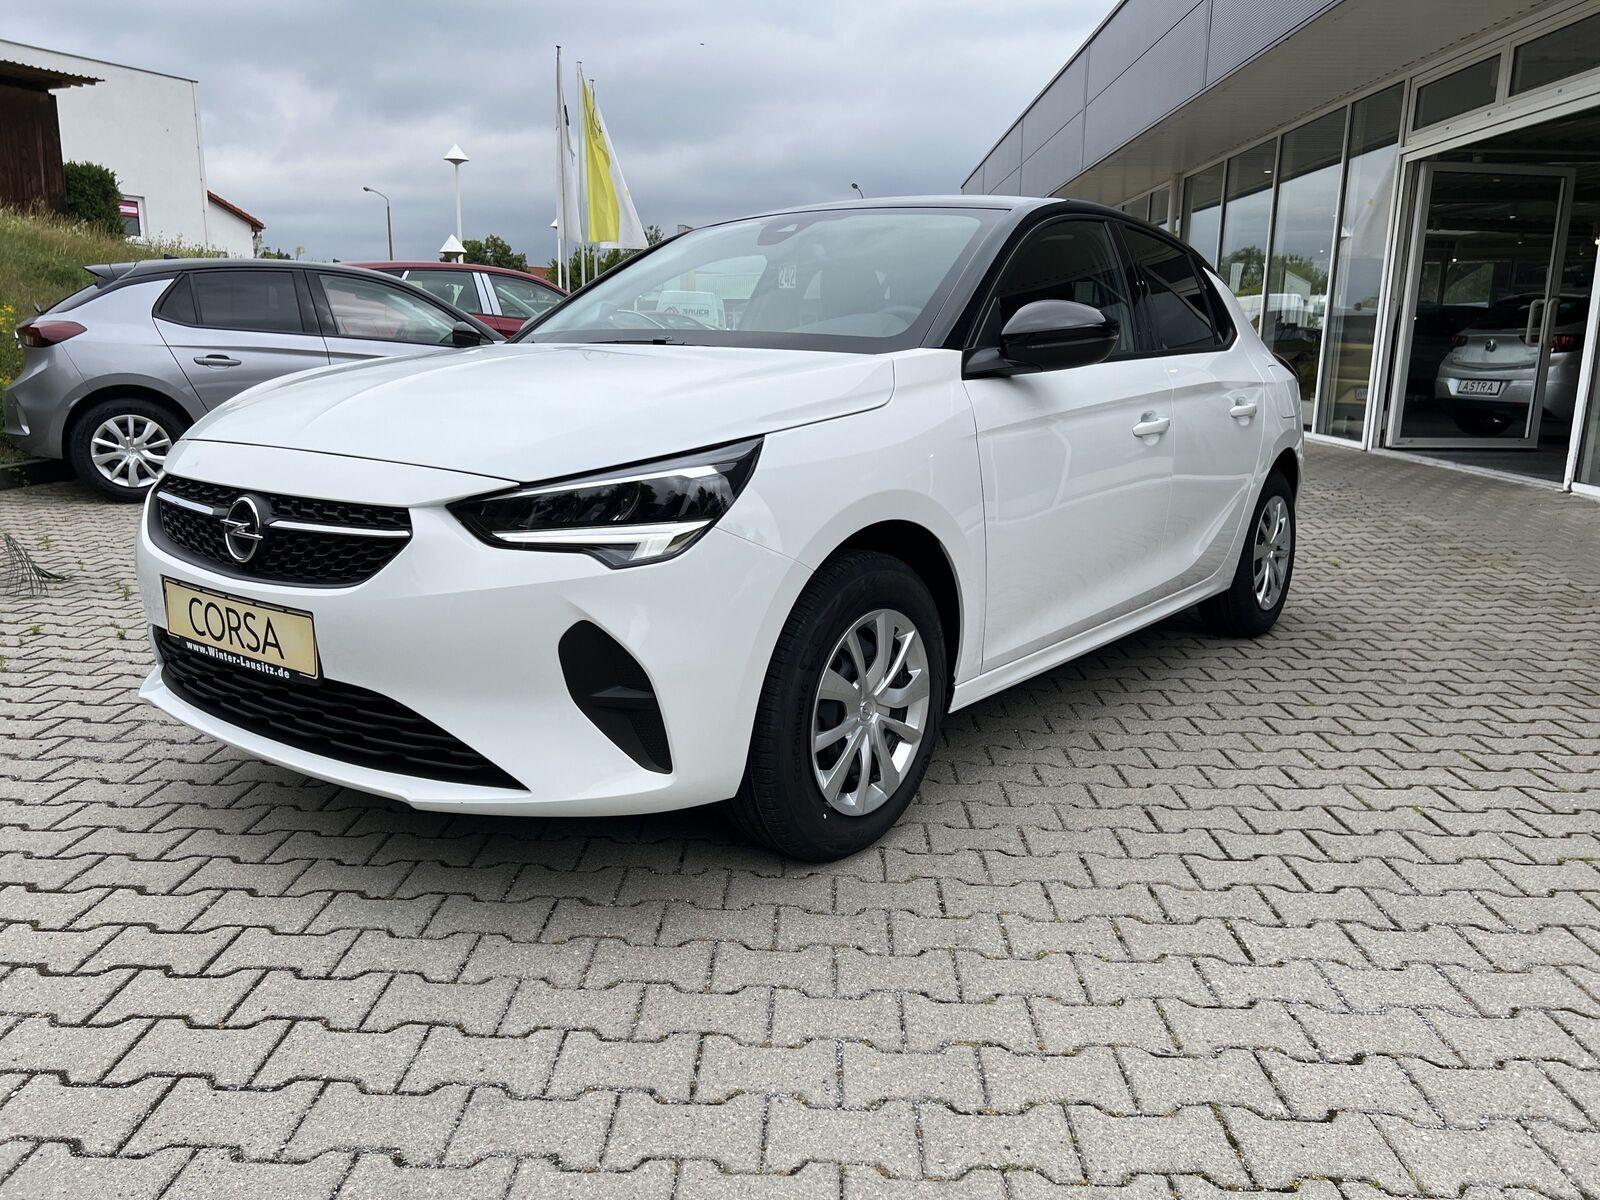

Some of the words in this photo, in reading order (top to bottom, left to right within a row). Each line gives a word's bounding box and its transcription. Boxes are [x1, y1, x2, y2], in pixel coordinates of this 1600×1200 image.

[1462, 381, 1493, 392] ASTRA
[188, 597, 285, 660] CORSA
[186, 640, 290, 679] www.Winter-Lausitz.de
